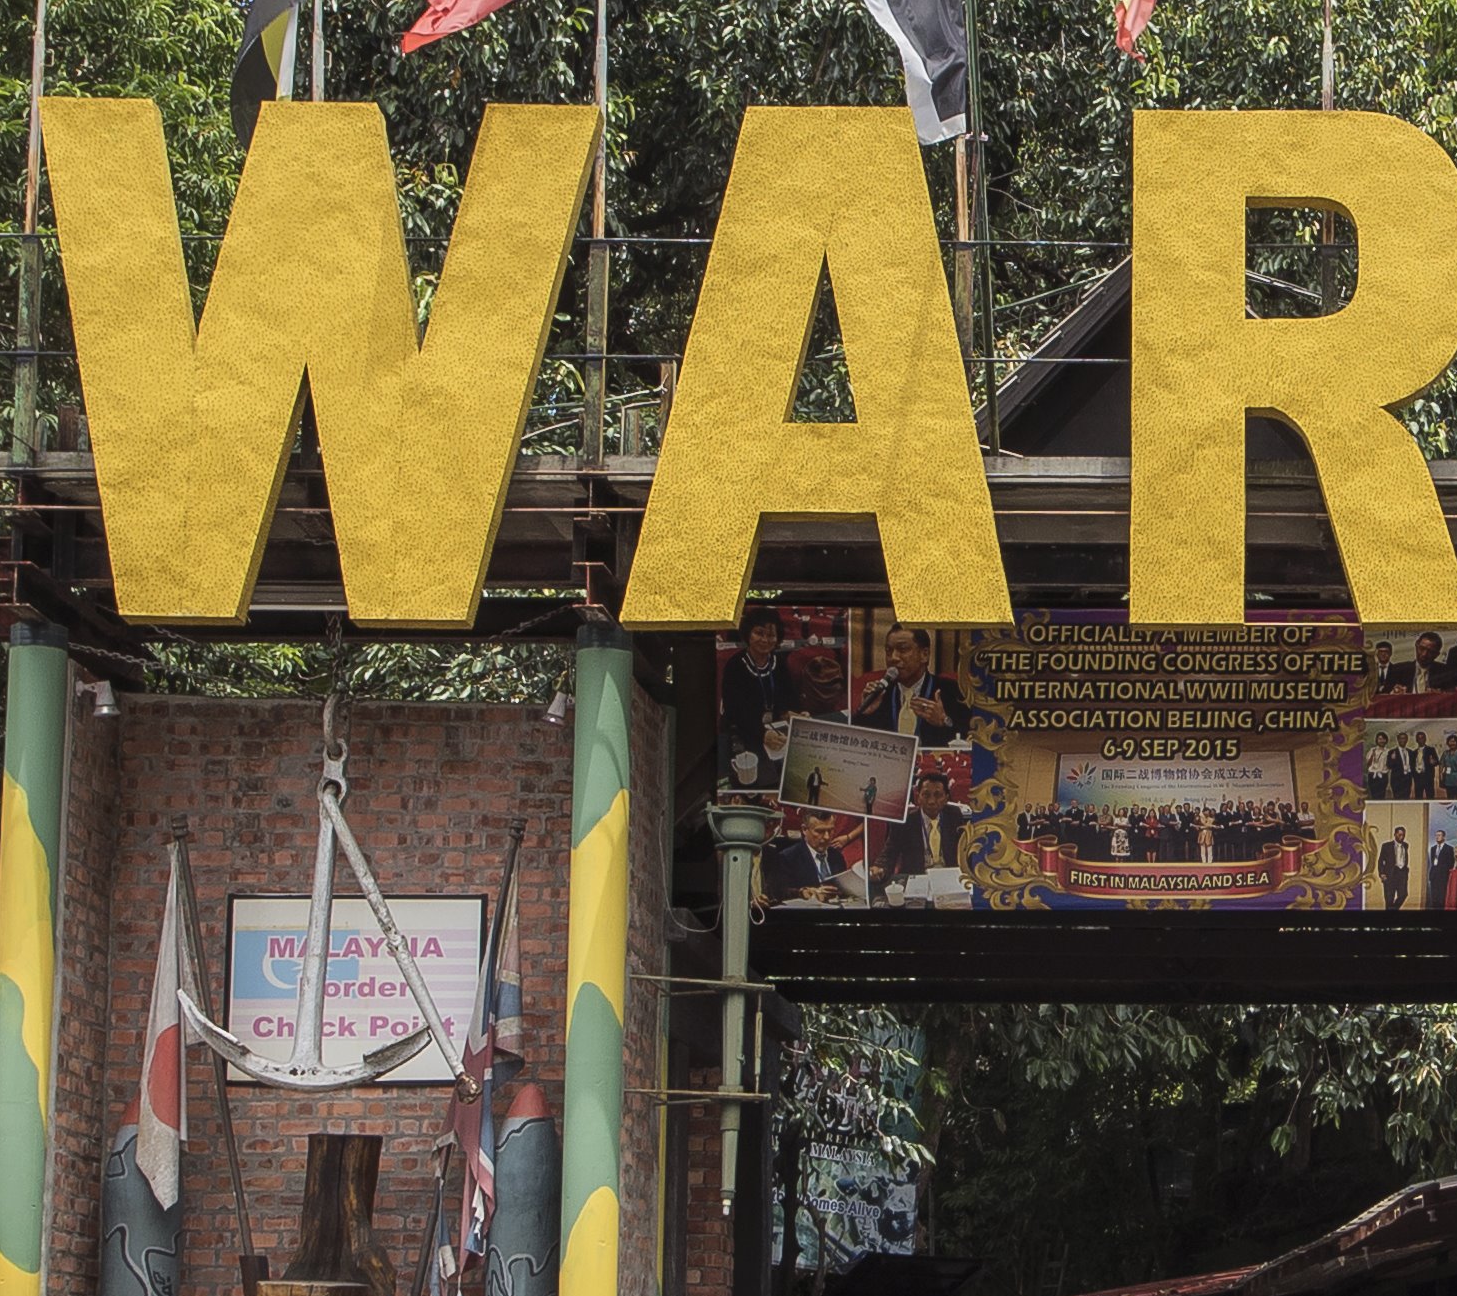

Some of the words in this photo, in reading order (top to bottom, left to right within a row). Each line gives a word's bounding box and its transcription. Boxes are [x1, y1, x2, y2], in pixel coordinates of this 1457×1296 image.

[1029, 625, 1154, 642] OFFICIALLY
[1160, 629, 1177, 643] A
[1183, 626, 1276, 643] MEMBER
[1283, 625, 1314, 643] OF
[1037, 652, 1157, 672] FOUNDING
[1162, 652, 1279, 672] CONGRESS
[1283, 652, 1316, 672] OF
[1319, 652, 1363, 672] THE
[995, 680, 1180, 700] INTERNATIONAL
[1184, 680, 1244, 700] WWII
[1250, 680, 1346, 700] MUSEUM
[1009, 709, 1161, 729] ASSOCIATION
[1168, 709, 1253, 729] BEIJING
[1101, 739, 1135, 758] 6-9
[1141, 739, 1179, 758] SEP
[1185, 739, 1238, 758] 2015
[1101, 767, 1264, 781] 国际二战博物馆协会成立大会
[1070, 870, 1107, 886] FIRST
[1109, 873, 1125, 887] IN
[1127, 875, 1198, 890] MALAYSIA
[1202, 874, 1233, 889] AND
[1235, 871, 1270, 886] S.E.A
[300, 976, 411, 999] order
[252, 1015, 358, 1038] Chck
[369, 1015, 455, 1037] Poit
